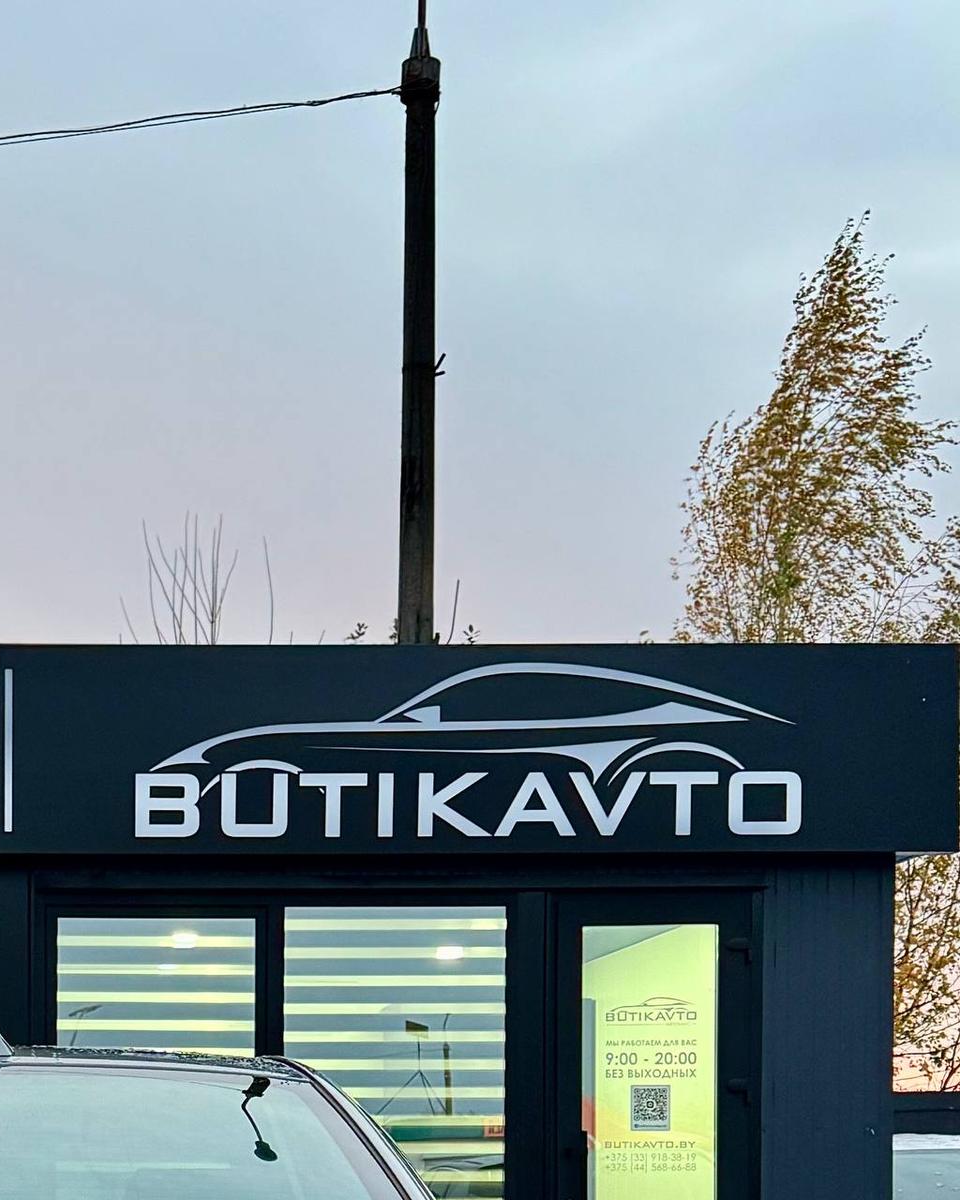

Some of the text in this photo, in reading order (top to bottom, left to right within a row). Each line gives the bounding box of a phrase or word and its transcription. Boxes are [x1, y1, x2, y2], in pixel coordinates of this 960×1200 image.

[135, 771, 802, 838] BUTIKAVTO
[605, 1011, 697, 1021] BUTIKAVTO
[606, 1052, 638, 1065] 9:00
[654, 1052, 697, 1065] 20:00
[605, 1069, 696, 1079] БЕЗ ВЫХОДНЫХ
[605, 1141, 695, 1149] BUTIKAVTO.BY
[606, 1152, 696, 1163] +375 (33) 918-38-19
[606, 1163, 627, 1172] +375
[631, 1162, 647, 1174] (44)
